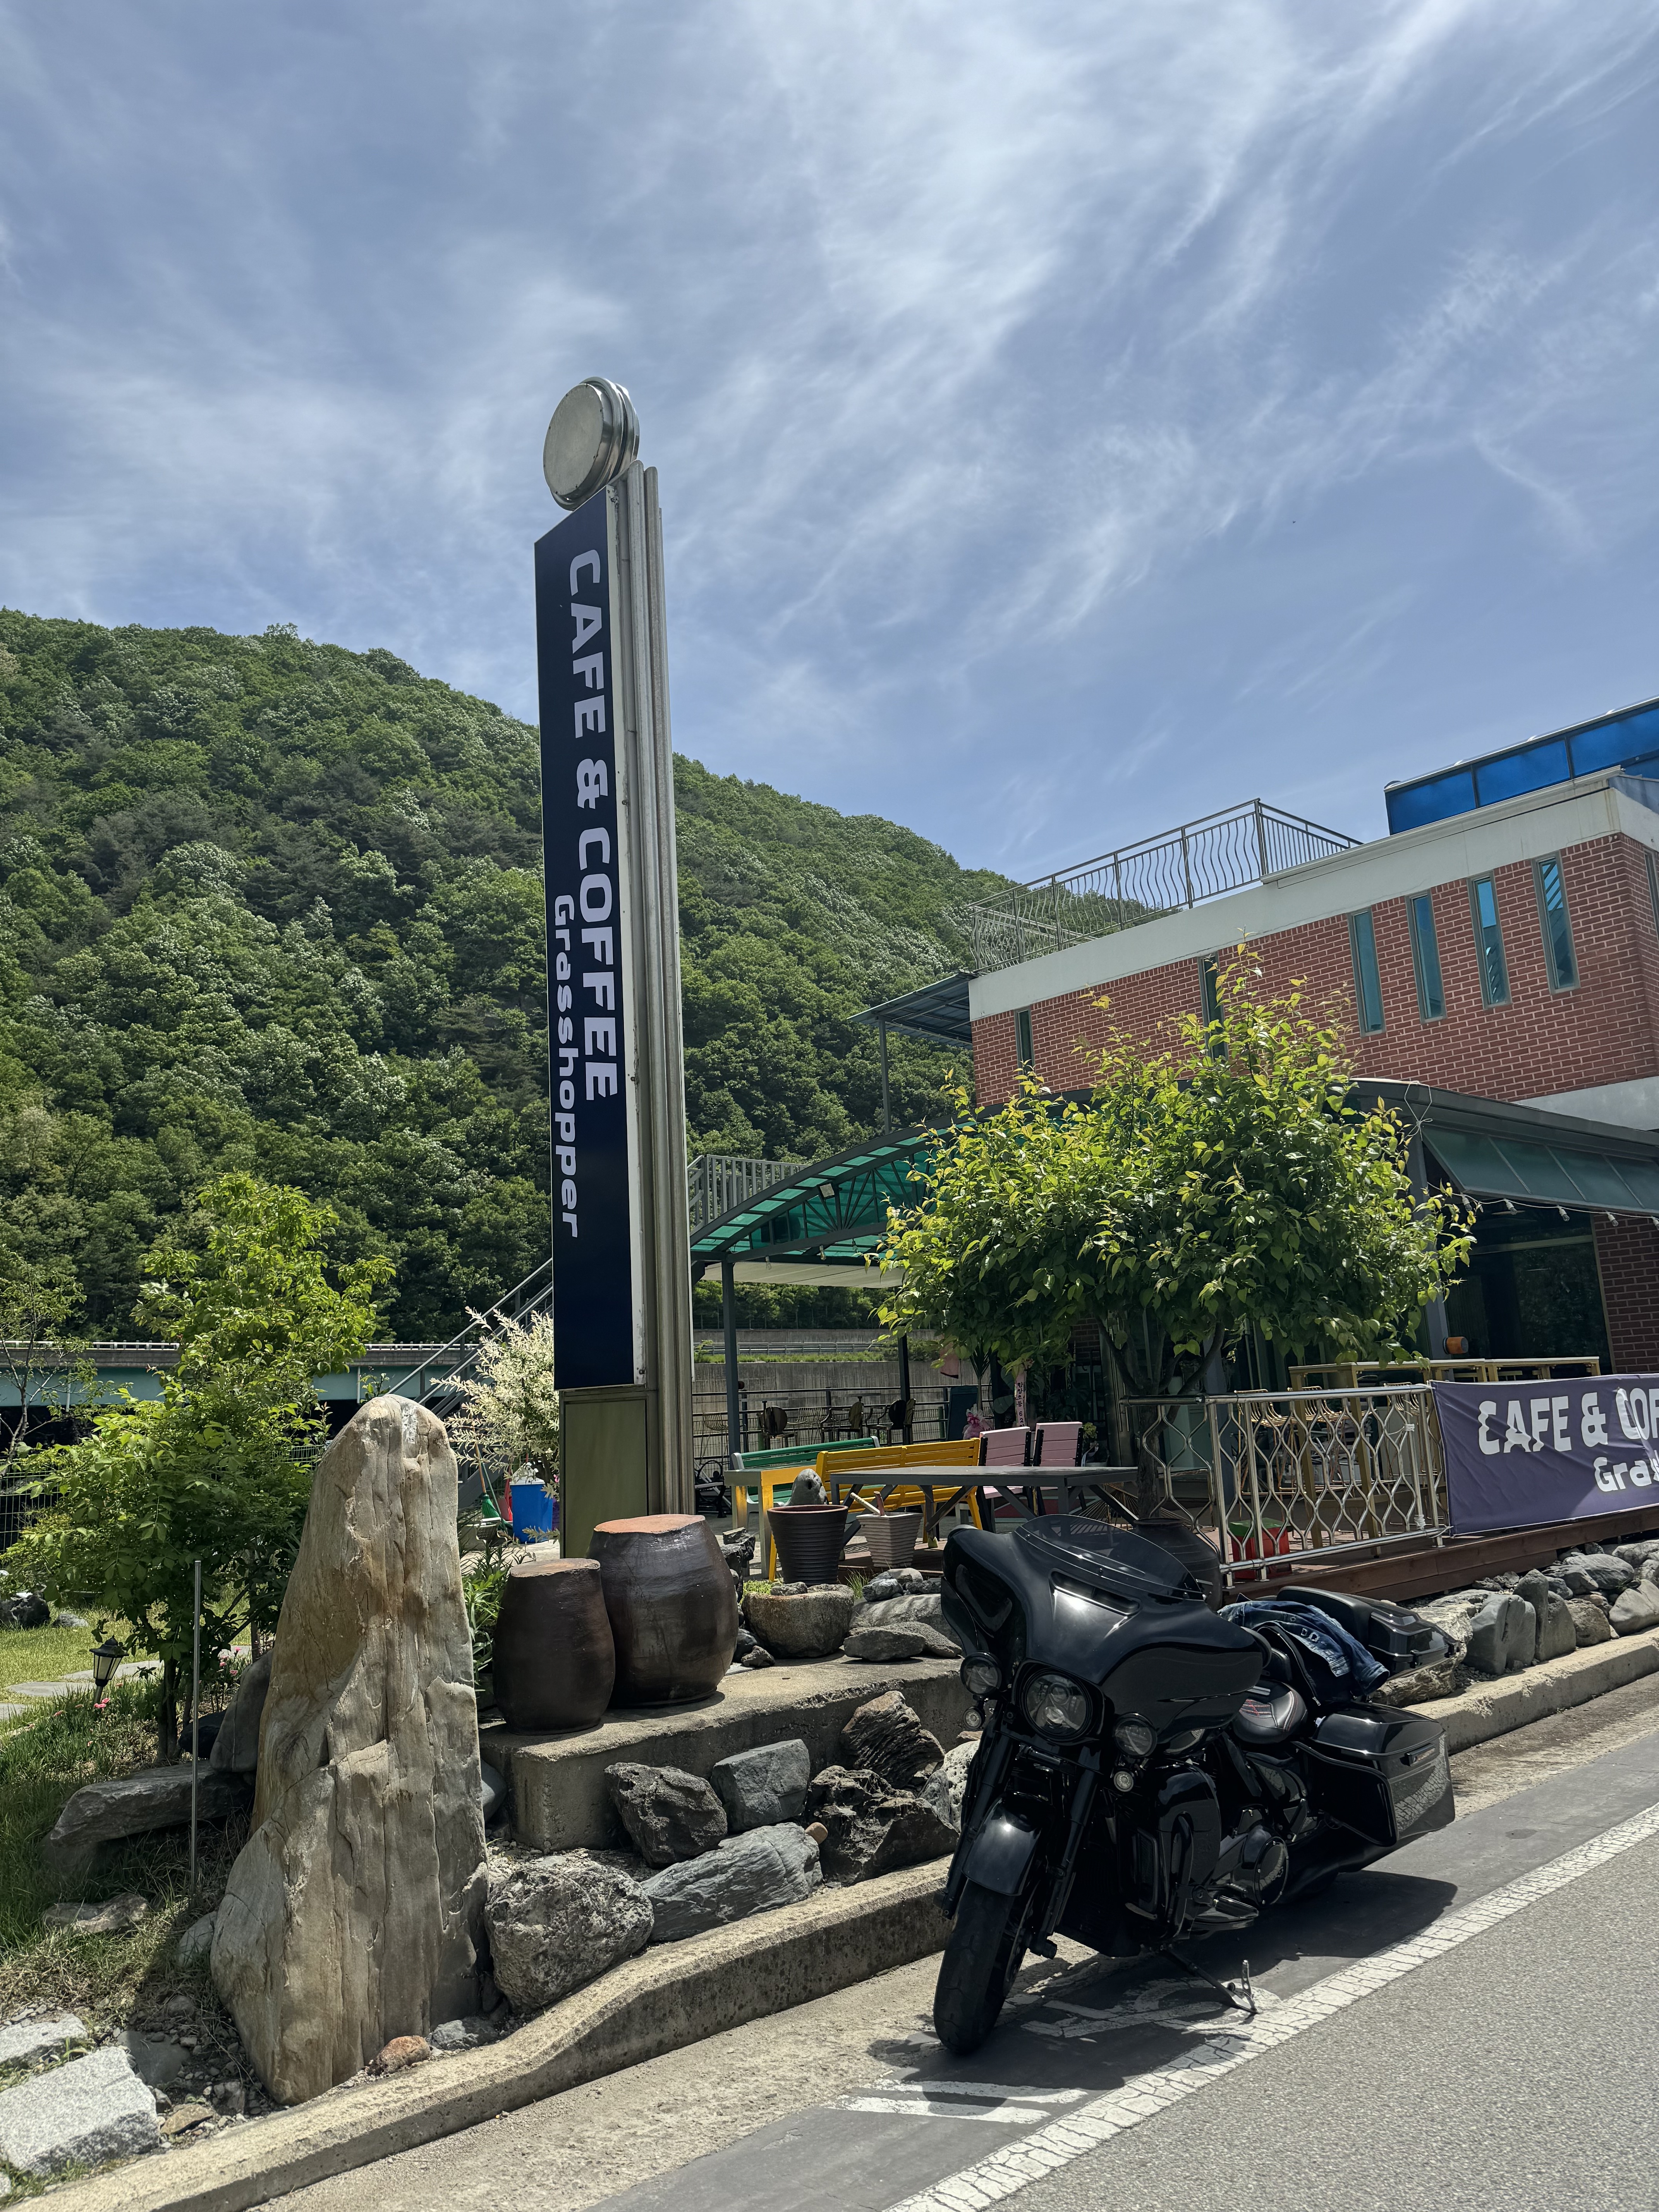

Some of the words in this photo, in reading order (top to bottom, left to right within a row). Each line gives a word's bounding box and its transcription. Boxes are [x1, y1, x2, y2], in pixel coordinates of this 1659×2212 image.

[570, 549, 606, 738] CAFE
[576, 758, 608, 809] &
[579, 827, 618, 1101] COFFEE
[555, 895, 579, 1238] Grasshopper
[1478, 1395, 1572, 1455] CAFE
[1581, 1392, 1608, 1447] &
